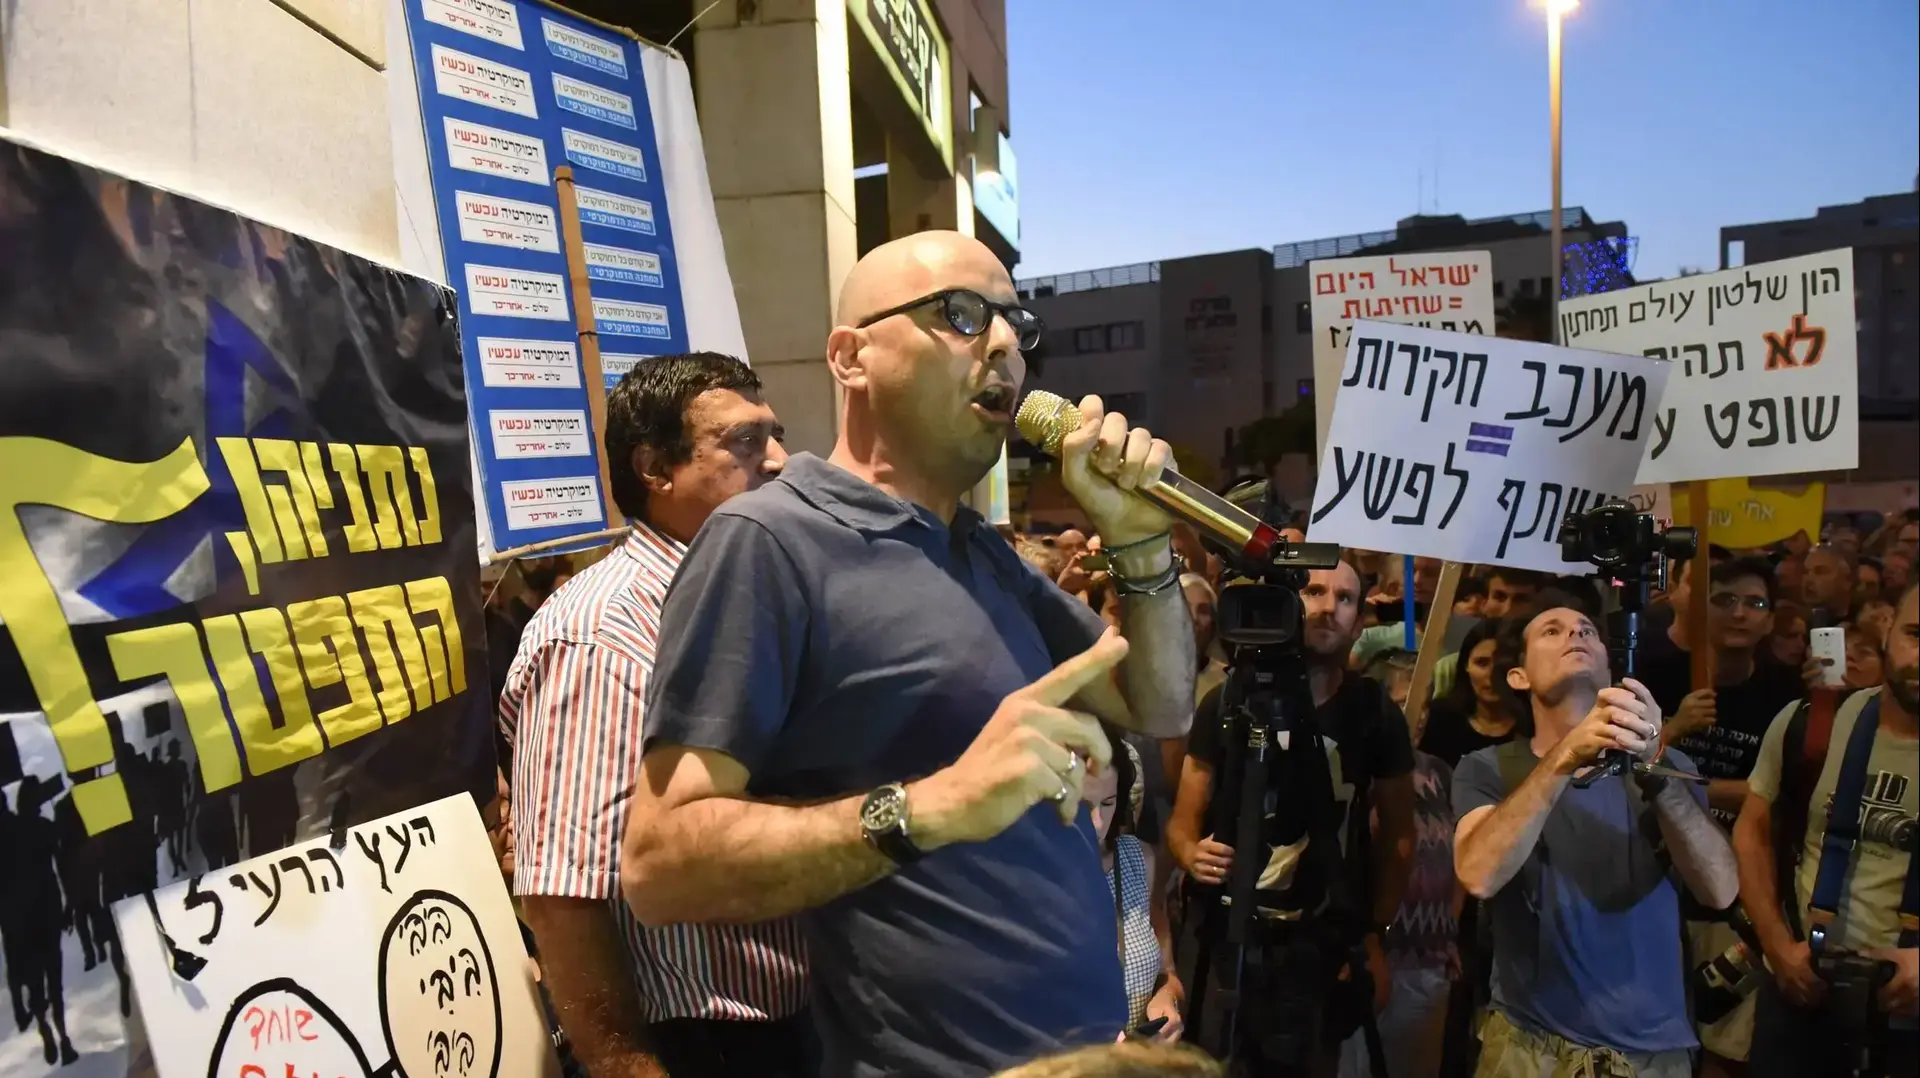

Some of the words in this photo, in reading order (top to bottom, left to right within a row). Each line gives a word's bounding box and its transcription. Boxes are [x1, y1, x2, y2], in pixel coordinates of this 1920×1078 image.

[441, 56, 475, 74] עכשיו
[476, 66, 525, 90] דמוקרטיה
[454, 128, 488, 145] עכשיו
[490, 136, 539, 157] דמוקרטיה
[465, 202, 499, 216] עכשיו
[501, 208, 549, 226] דמוקרטיה
[475, 274, 508, 288] עכשיו
[1316, 271, 1375, 295] היום
[1389, 257, 1479, 287] ישראל
[510, 278, 558, 296] דמוקרטיה
[1708, 270, 1788, 326] שלטון
[1801, 267, 1840, 316] הון
[1629, 287, 1695, 323] עולם
[1561, 305, 1618, 347] תחתון
[488, 347, 520, 358] עכשיו
[1762, 312, 1827, 371] לא
[523, 348, 571, 363] דמוקרטיה
[1342, 337, 1489, 423] חקירות
[1504, 361, 1647, 443] מעכב
[498, 419, 531, 430] עכשיו
[534, 418, 580, 432] דמוקרטיה
[1704, 395, 1840, 449] שופט
[512, 488, 544, 501] עכשיו
[546, 485, 592, 500] דמוקרטיה
[1312, 442, 1469, 530] לפשע
[354, 816, 436, 893] העץ
